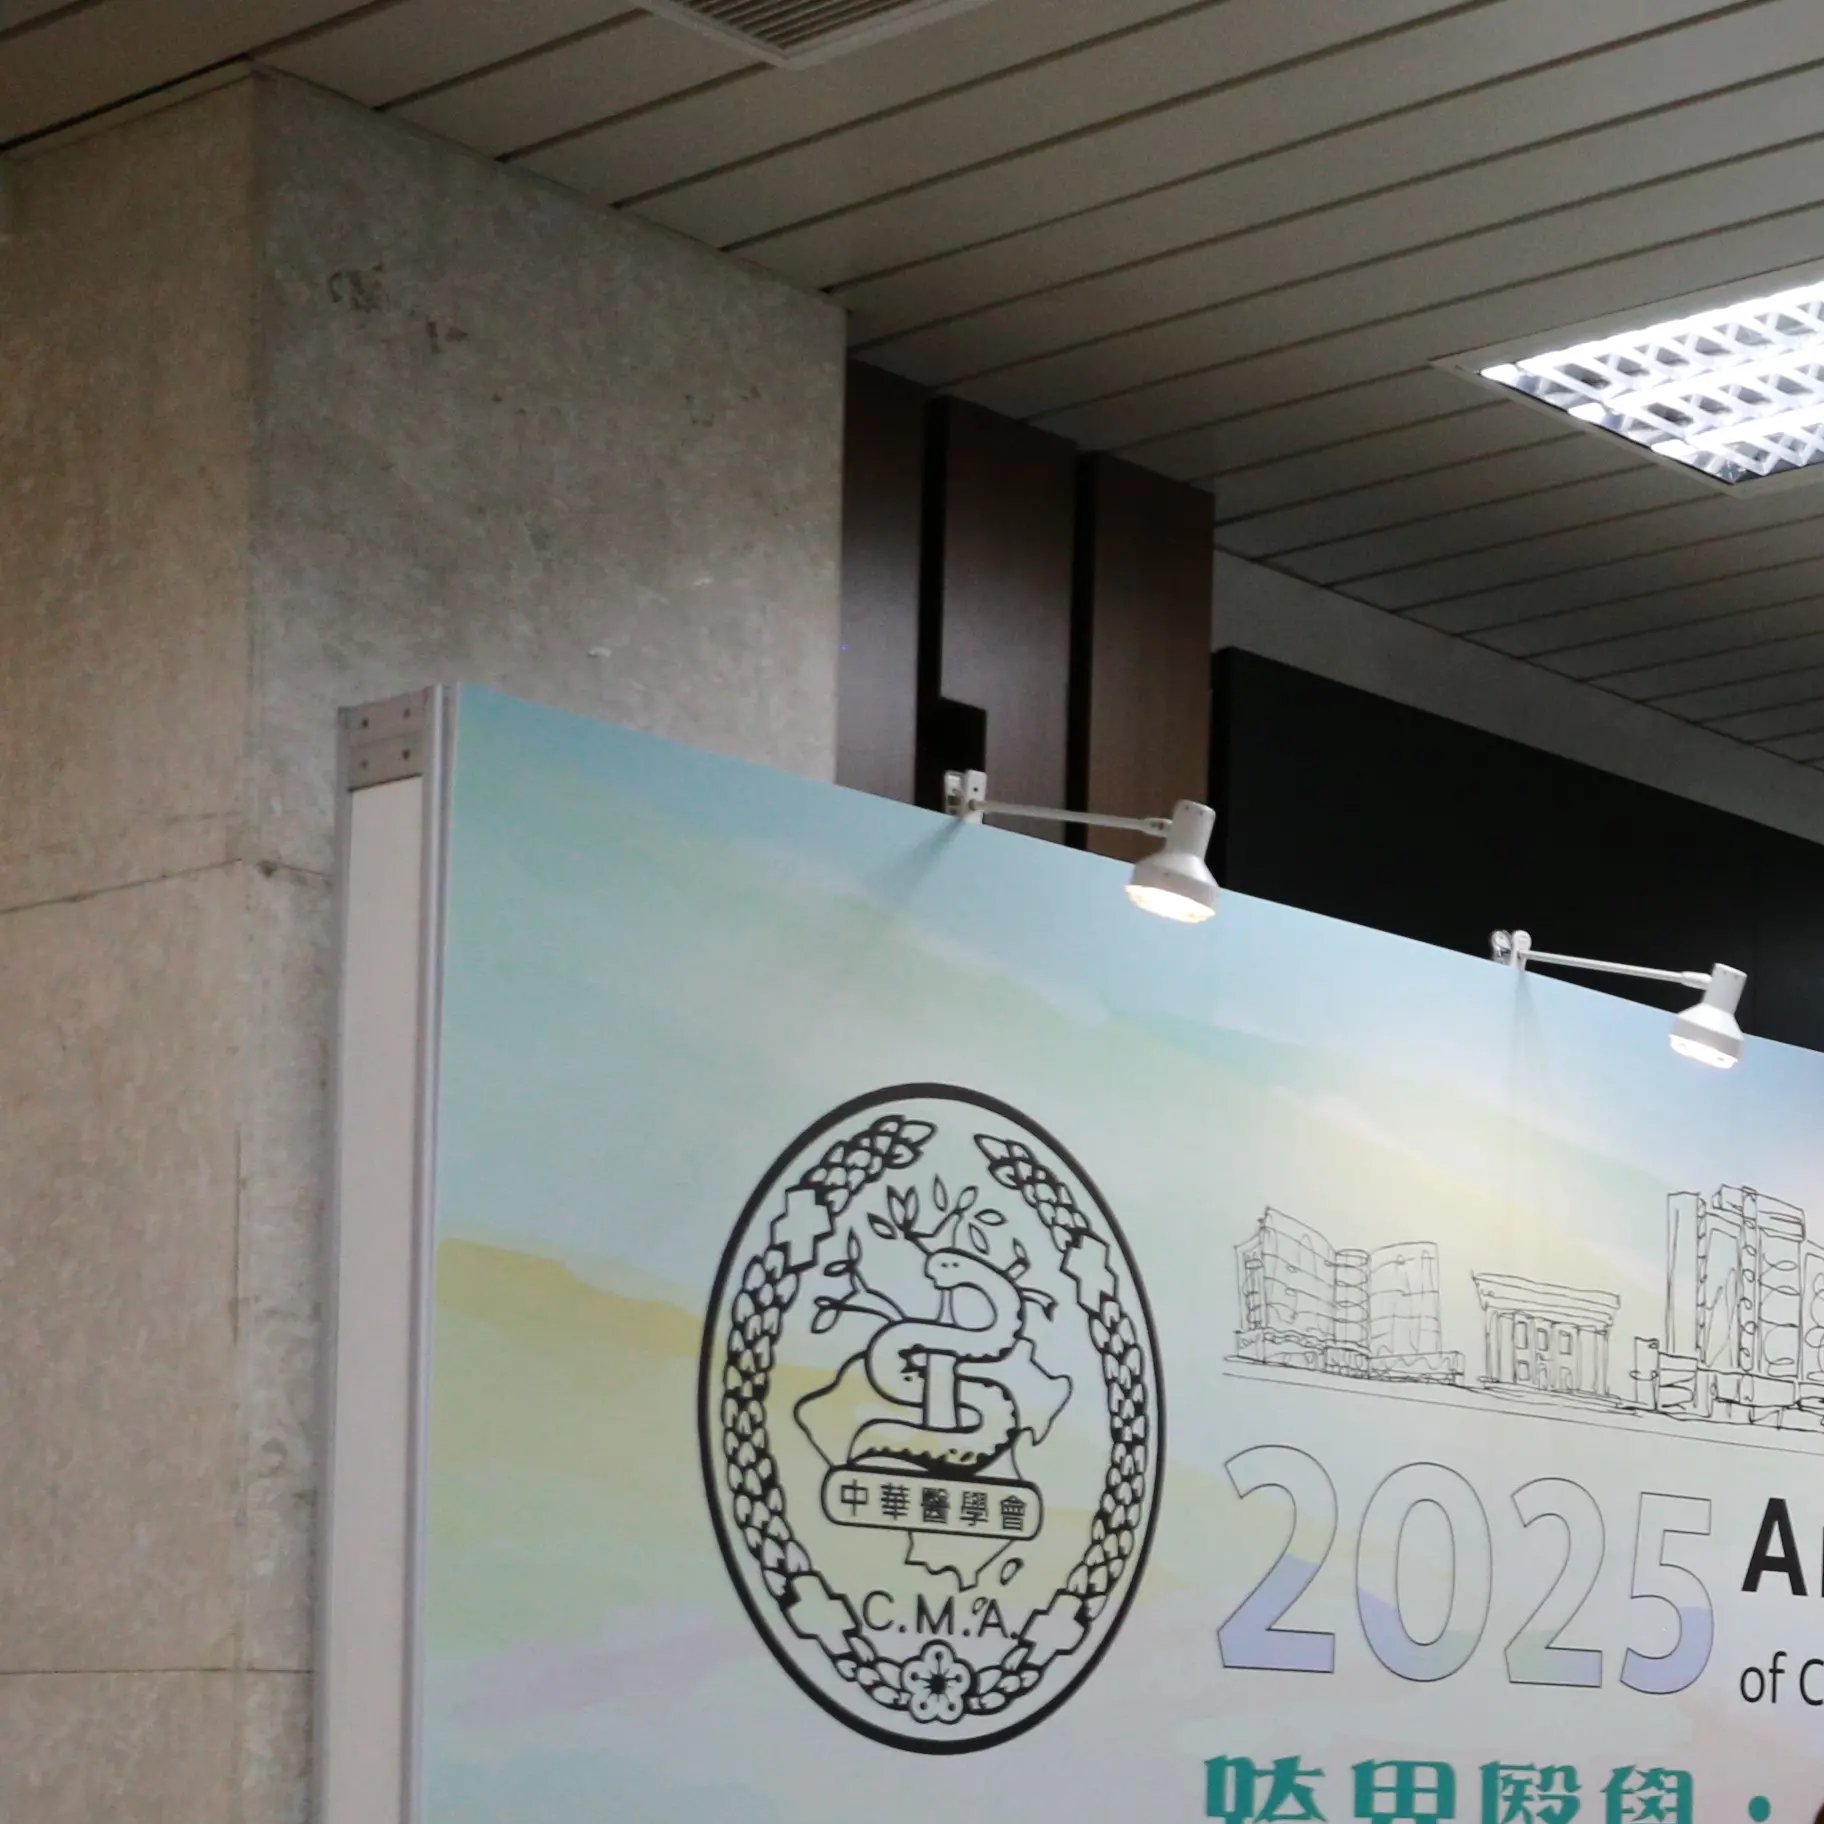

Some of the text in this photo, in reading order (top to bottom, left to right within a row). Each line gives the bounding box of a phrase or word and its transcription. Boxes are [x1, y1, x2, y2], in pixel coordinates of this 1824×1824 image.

[840, 1478, 1027, 1531] 中華醫學會
[1216, 1444, 1715, 1695] 2025
[1740, 1651, 1787, 1703] of
